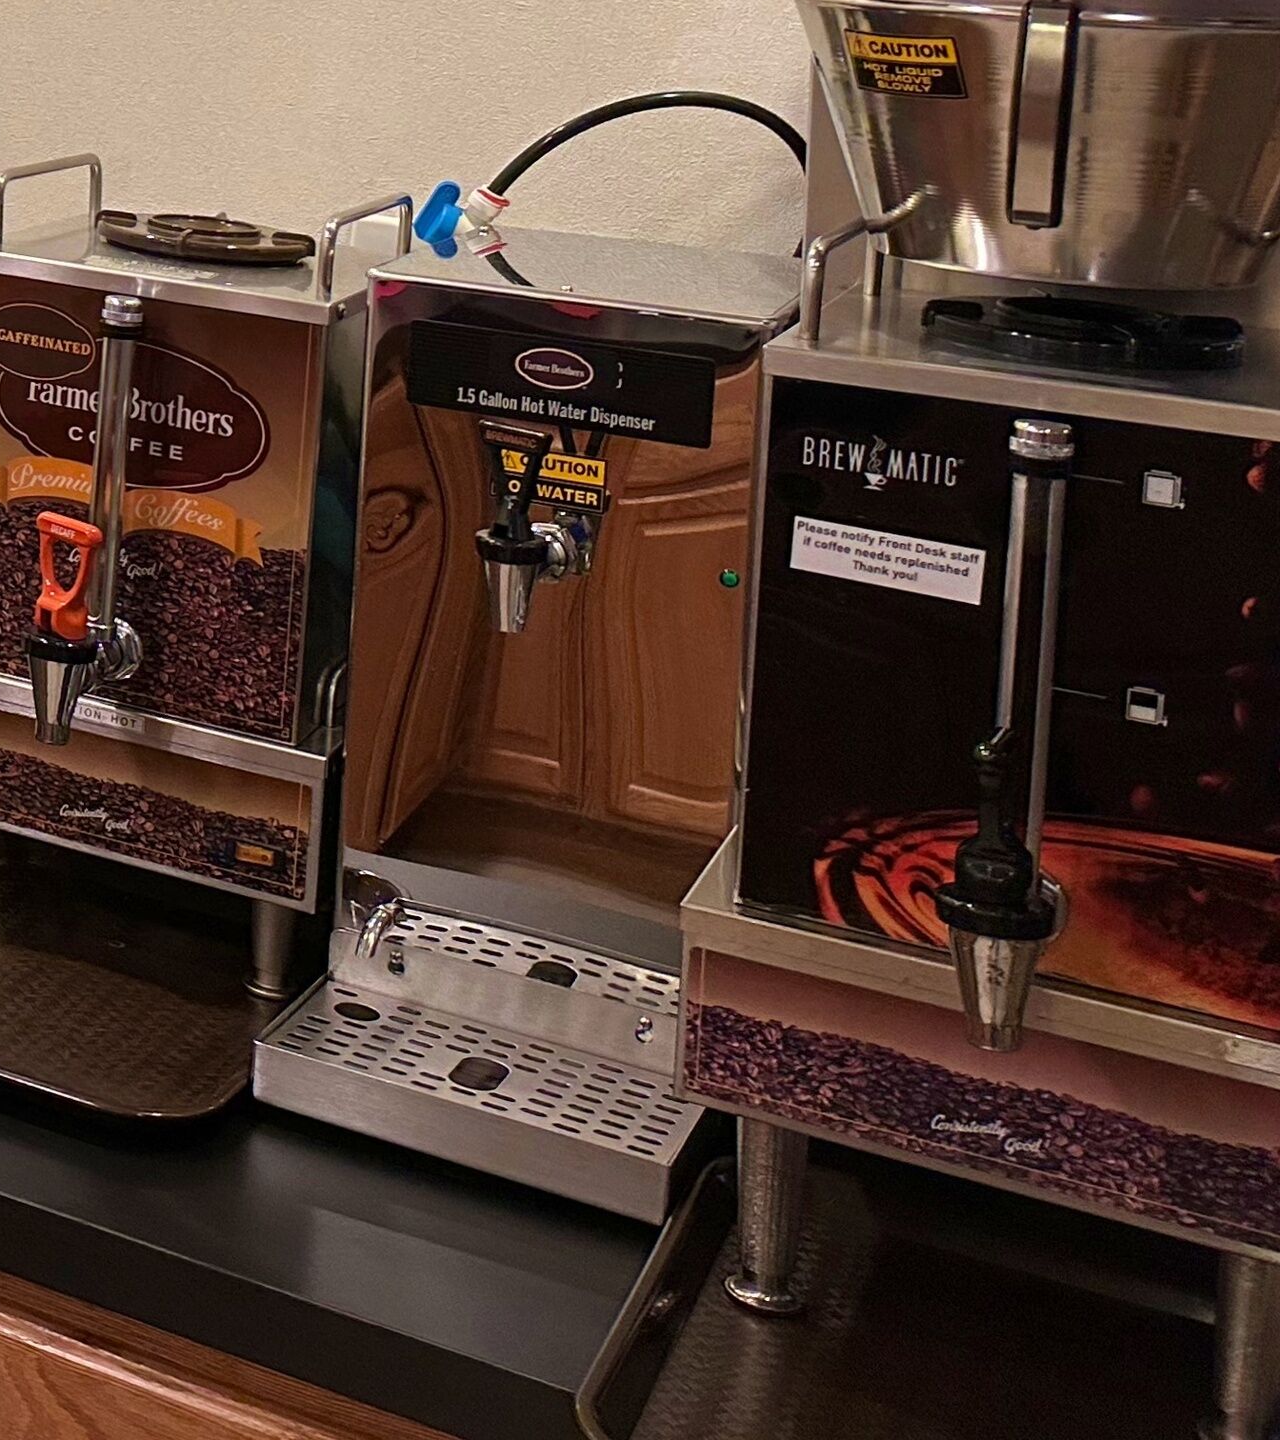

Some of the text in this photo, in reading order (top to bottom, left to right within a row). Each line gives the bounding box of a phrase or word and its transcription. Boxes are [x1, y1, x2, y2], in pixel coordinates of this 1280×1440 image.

[868, 40, 949, 59] CAUTION
[863, 61, 943, 78] HOT LIQUID
[874, 71, 931, 84] REMOVE
[877, 80, 931, 92] SLOWLY
[523, 360, 586, 378] Farmer Brothers
[457, 387, 657, 433] 1.5 Gallon Hot Water Dispenser
[536, 483, 600, 507] WATER
[133, 494, 225, 532] Coffees
[796, 520, 980, 564] Please notify Front Desk staff
[802, 535, 970, 578] if coffee needs replenished
[853, 560, 919, 581] Thank you!
[110, 713, 137, 728] HOT
[930, 1113, 1012, 1140] Consistently
